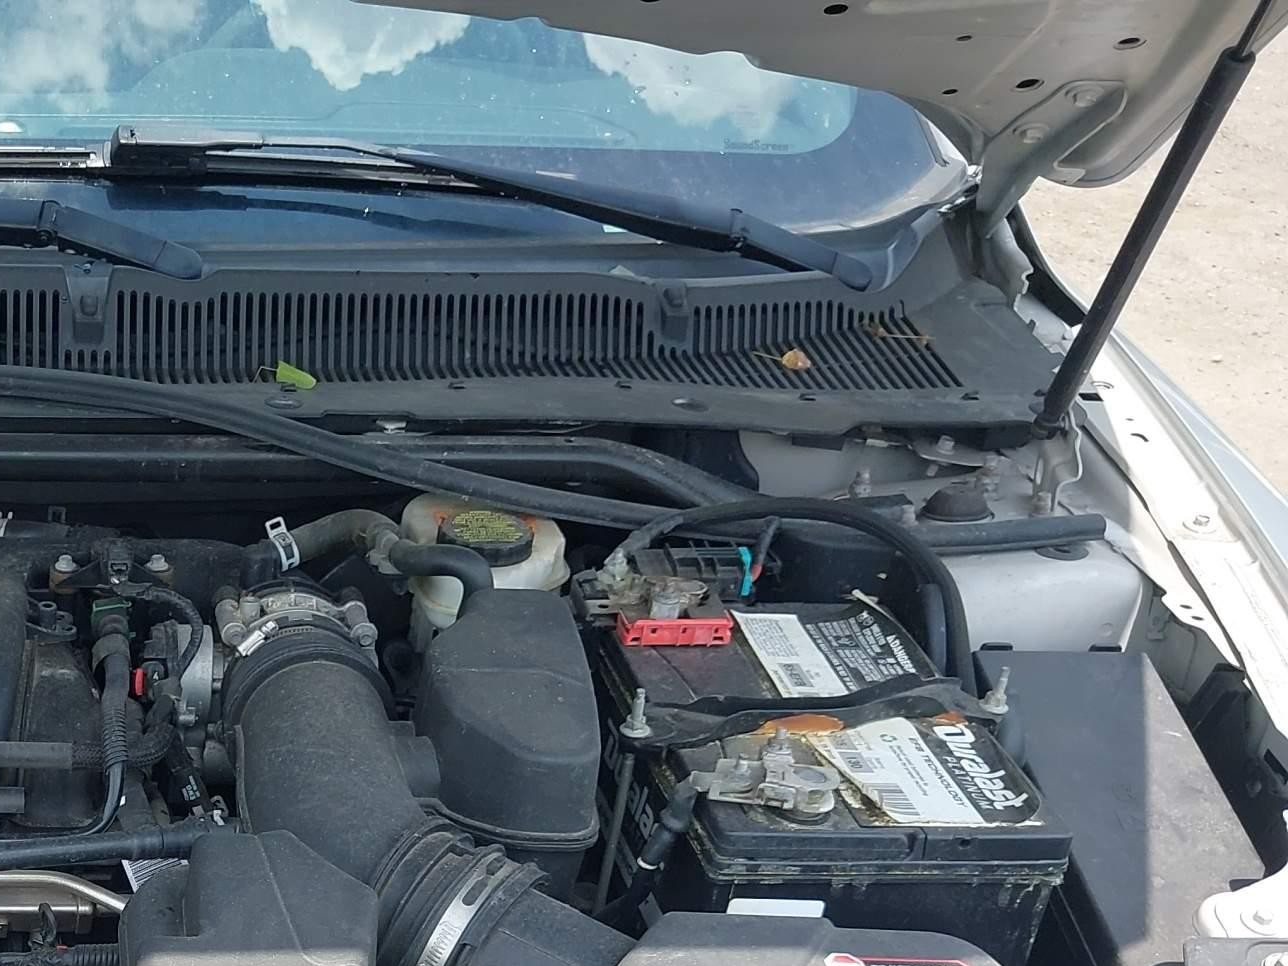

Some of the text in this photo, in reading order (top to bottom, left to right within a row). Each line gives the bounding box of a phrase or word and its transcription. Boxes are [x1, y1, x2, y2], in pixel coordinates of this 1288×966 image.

[922, 754, 969, 809] TECHNOLOGY
[933, 724, 1028, 810] Duralast
[942, 755, 994, 809] PLATINUM
